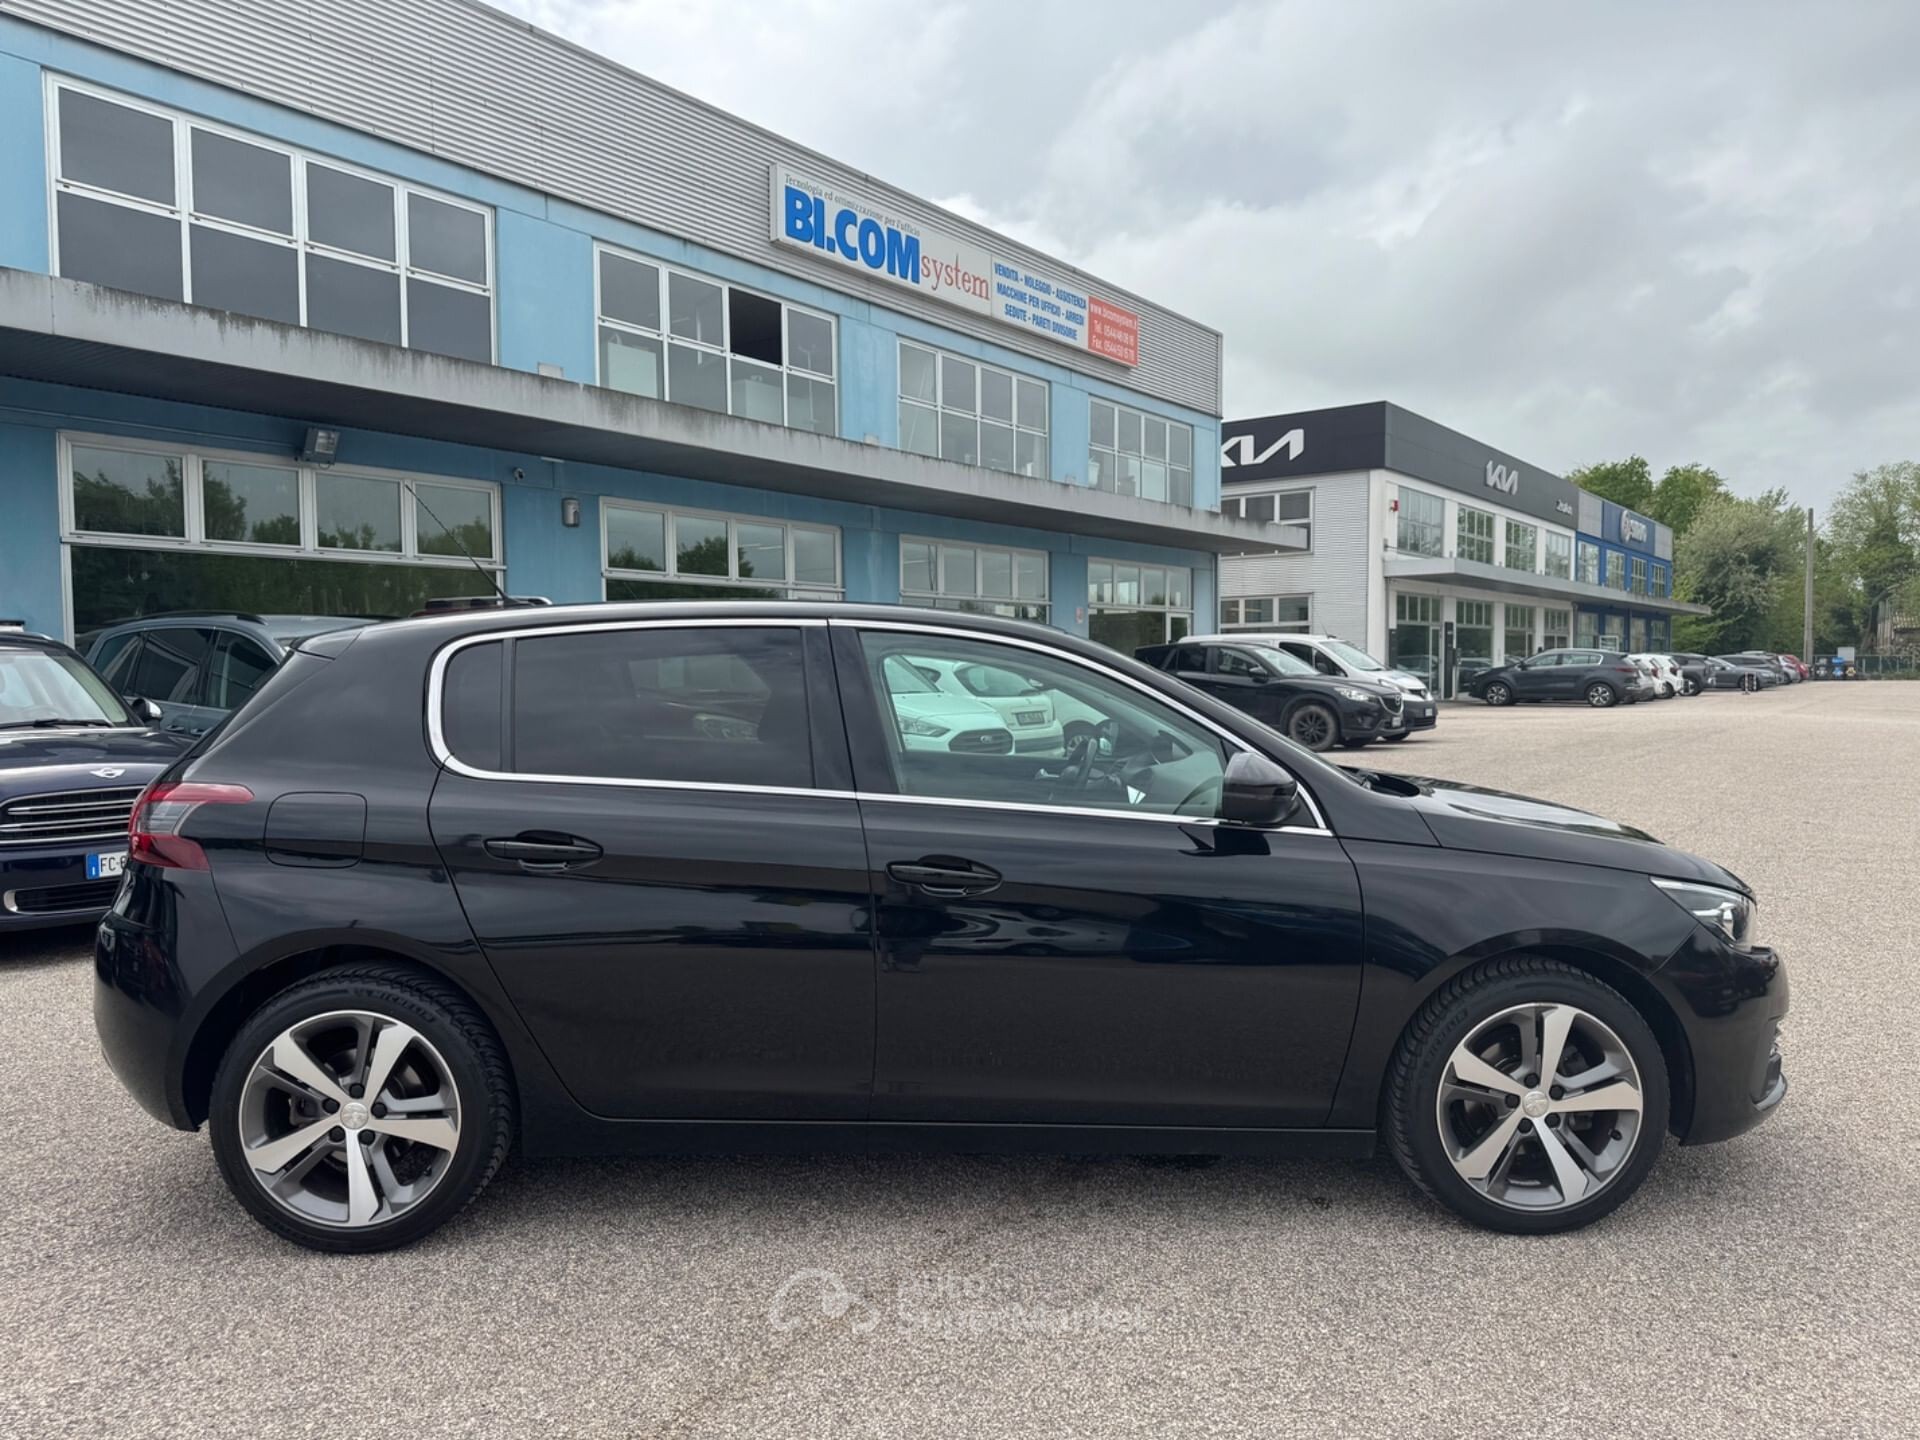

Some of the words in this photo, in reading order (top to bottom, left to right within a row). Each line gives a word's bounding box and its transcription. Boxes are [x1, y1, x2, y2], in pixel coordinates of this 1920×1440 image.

[785, 173, 823, 198] Tecnologia
[824, 190, 833, 202] ed
[884, 215, 897, 229] per
[785, 185, 920, 285] BI.COM
[921, 253, 990, 300] system
[994, 262, 1019, 283] VENDITA
[996, 282, 1028, 305] MACCHINE
[1028, 294, 1040, 310] PER
[1040, 297, 1061, 318] UFFICIO
[1004, 303, 1027, 323] SEDUTE
